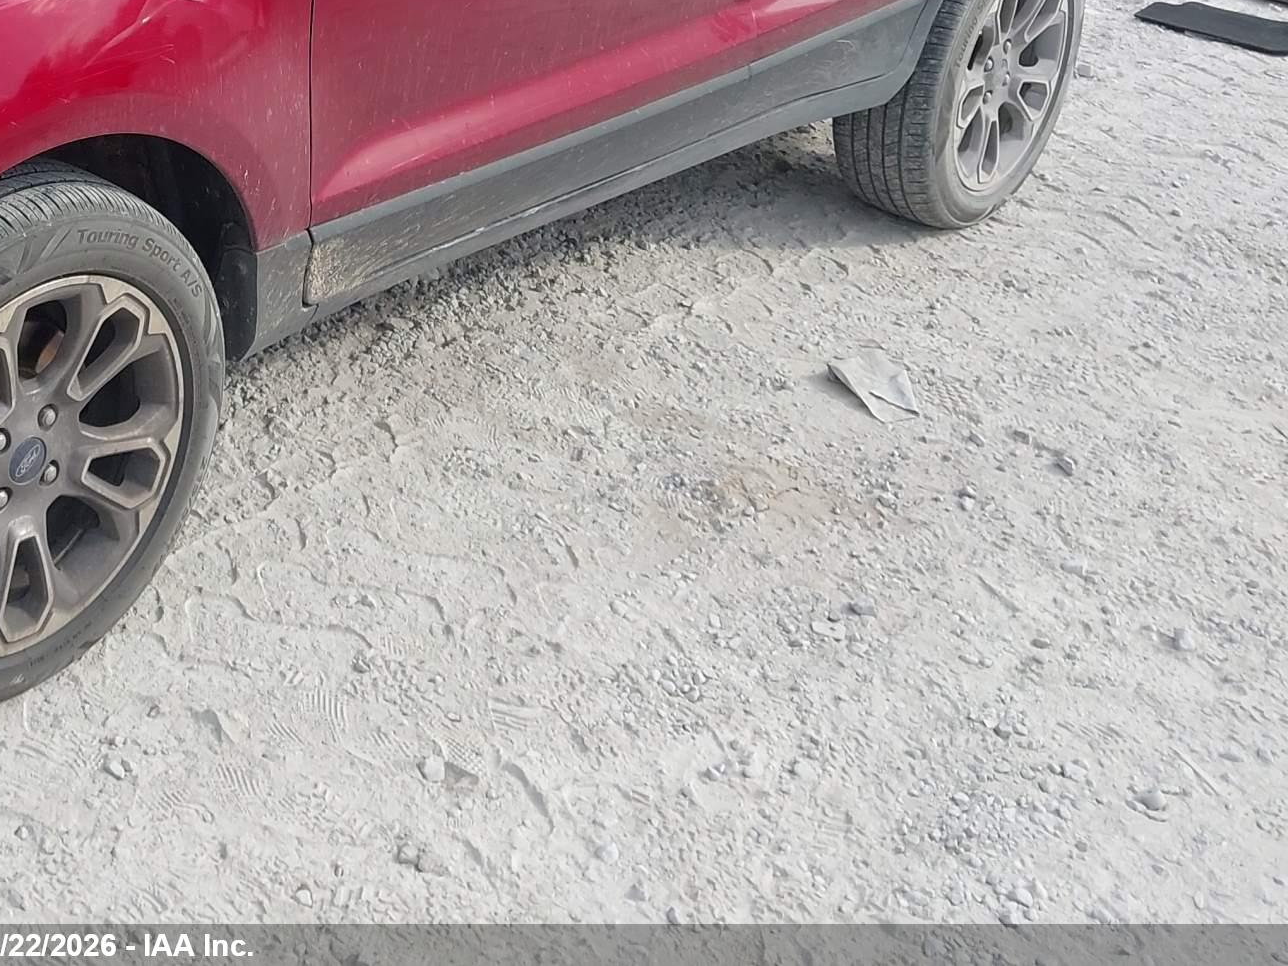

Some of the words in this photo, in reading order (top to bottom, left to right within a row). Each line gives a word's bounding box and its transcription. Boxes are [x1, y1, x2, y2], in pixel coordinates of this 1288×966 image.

[77, 229, 139, 250] Touring
[142, 237, 181, 272] Sport
[180, 270, 202, 298] A/S
